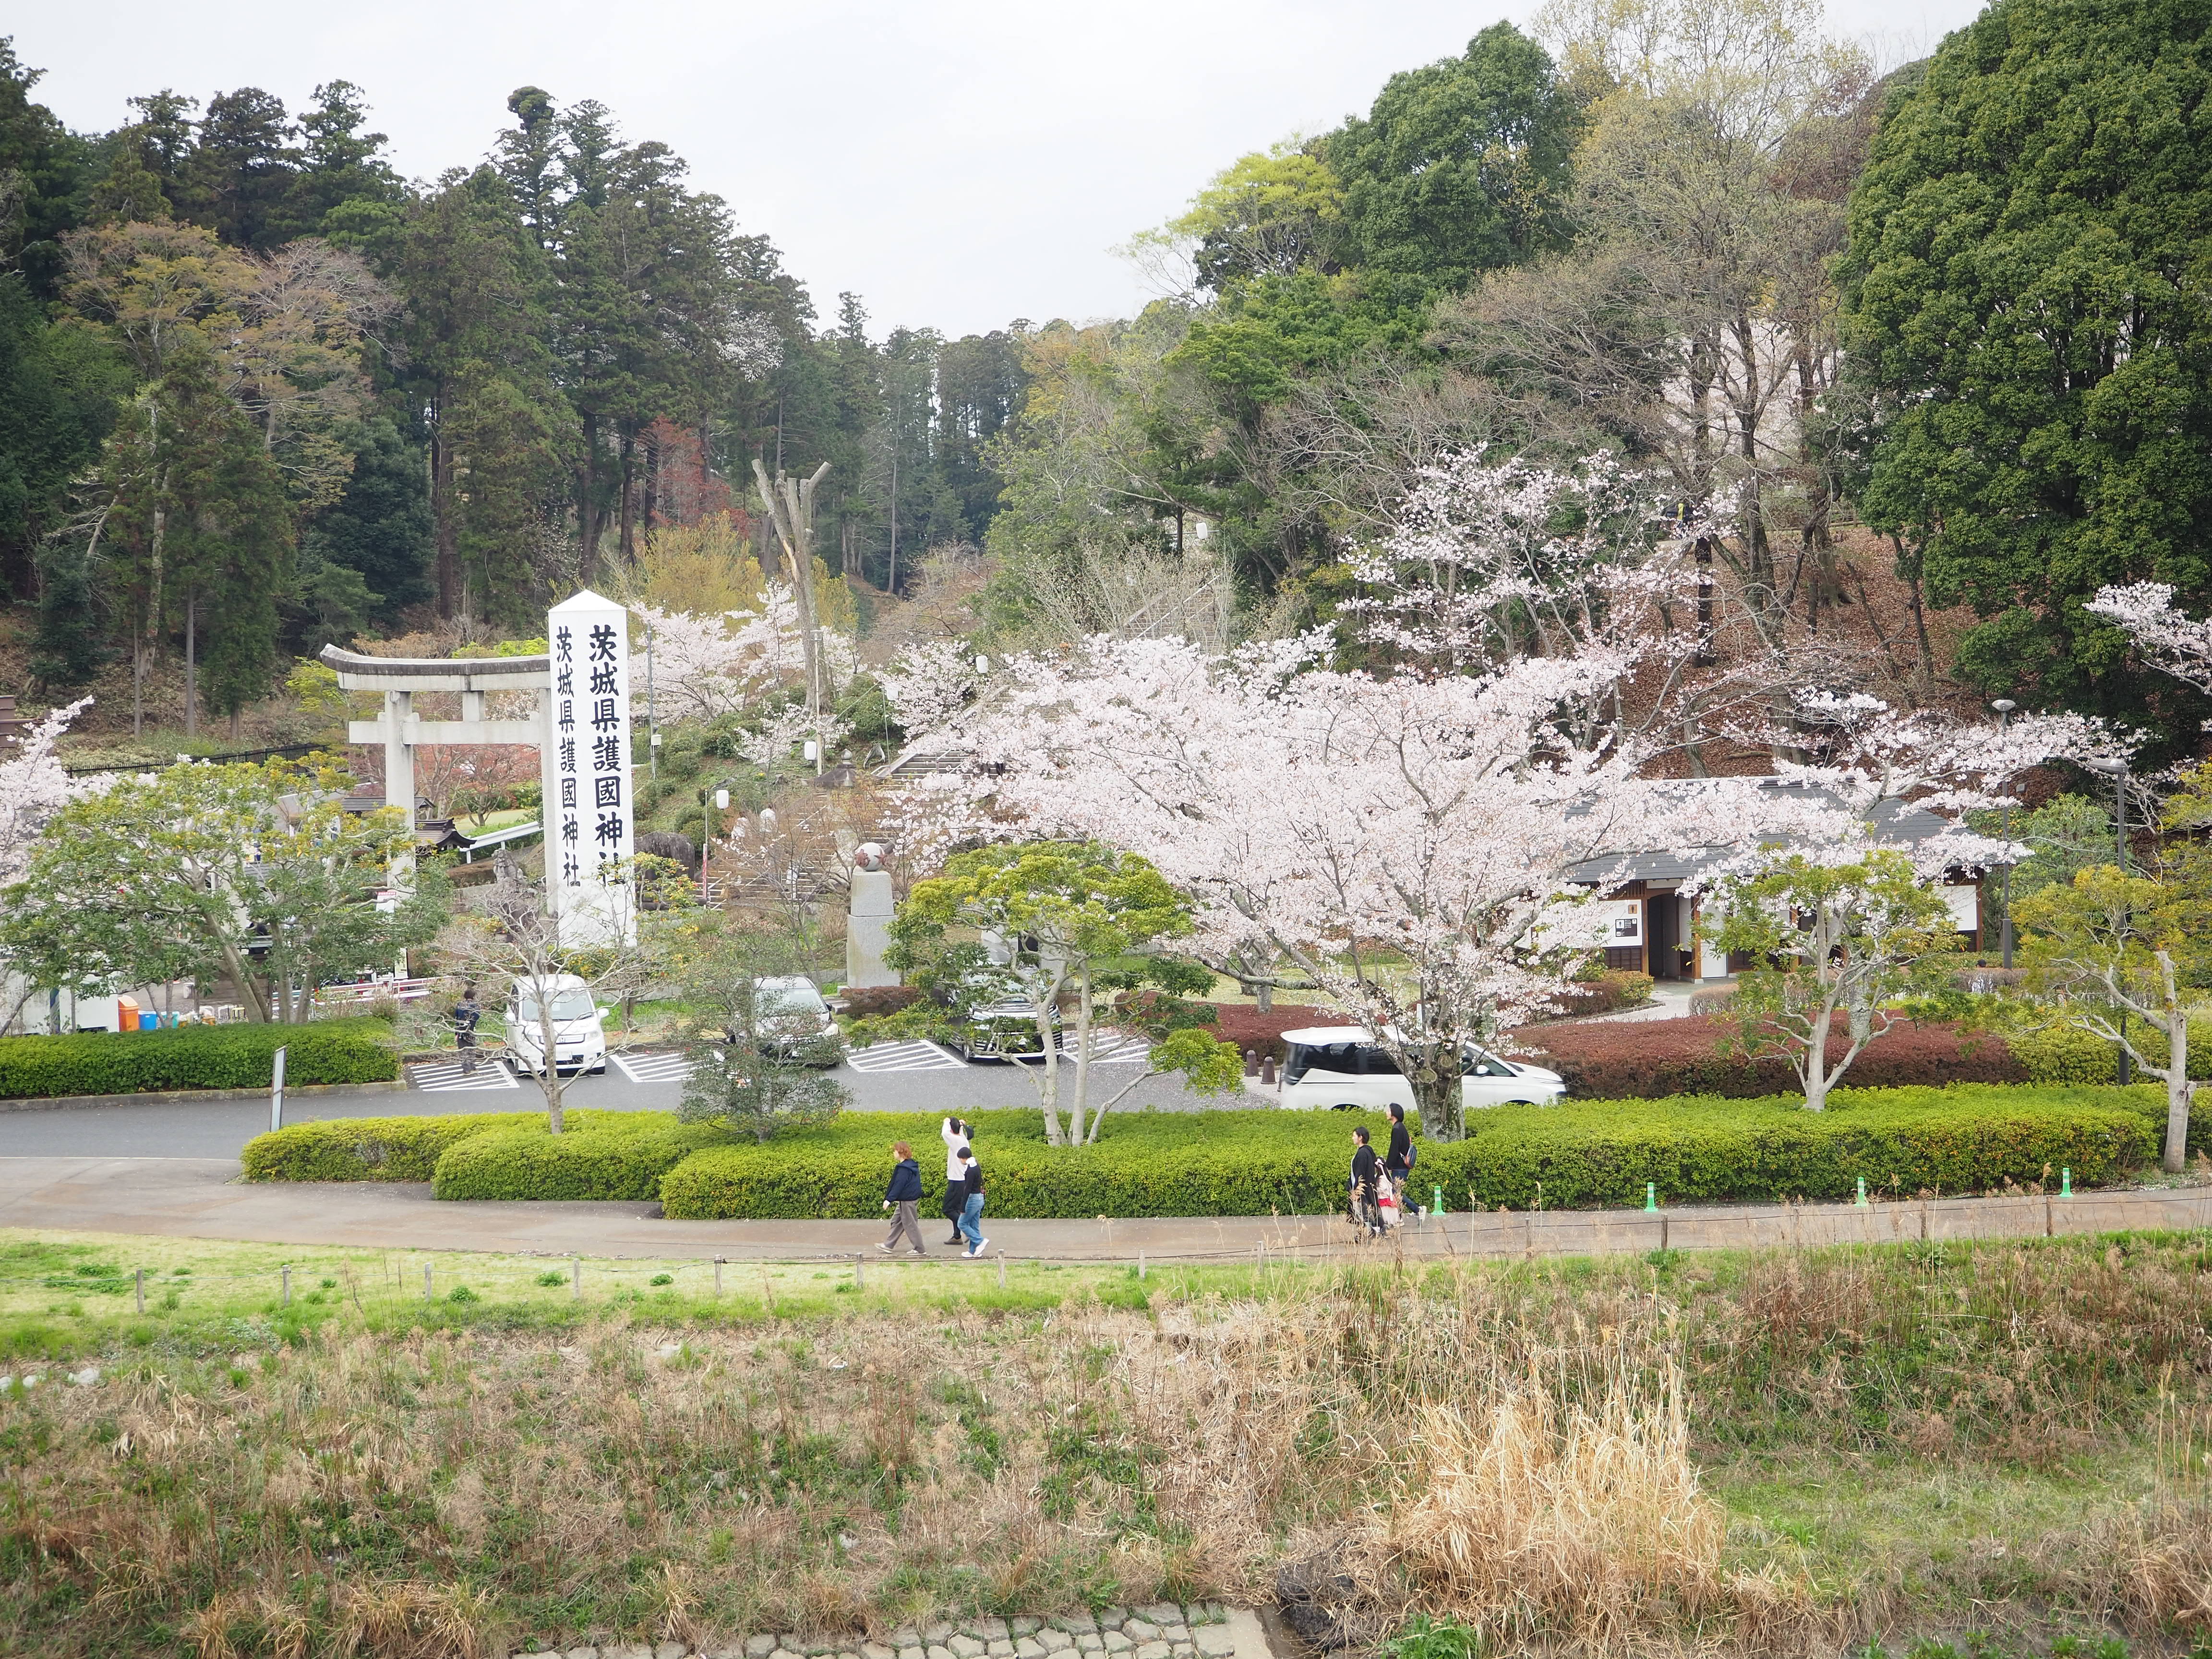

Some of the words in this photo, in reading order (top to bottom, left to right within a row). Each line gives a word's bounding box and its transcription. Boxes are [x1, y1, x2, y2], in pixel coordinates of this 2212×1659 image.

[556, 625, 581, 888] 茨城県護國神社
